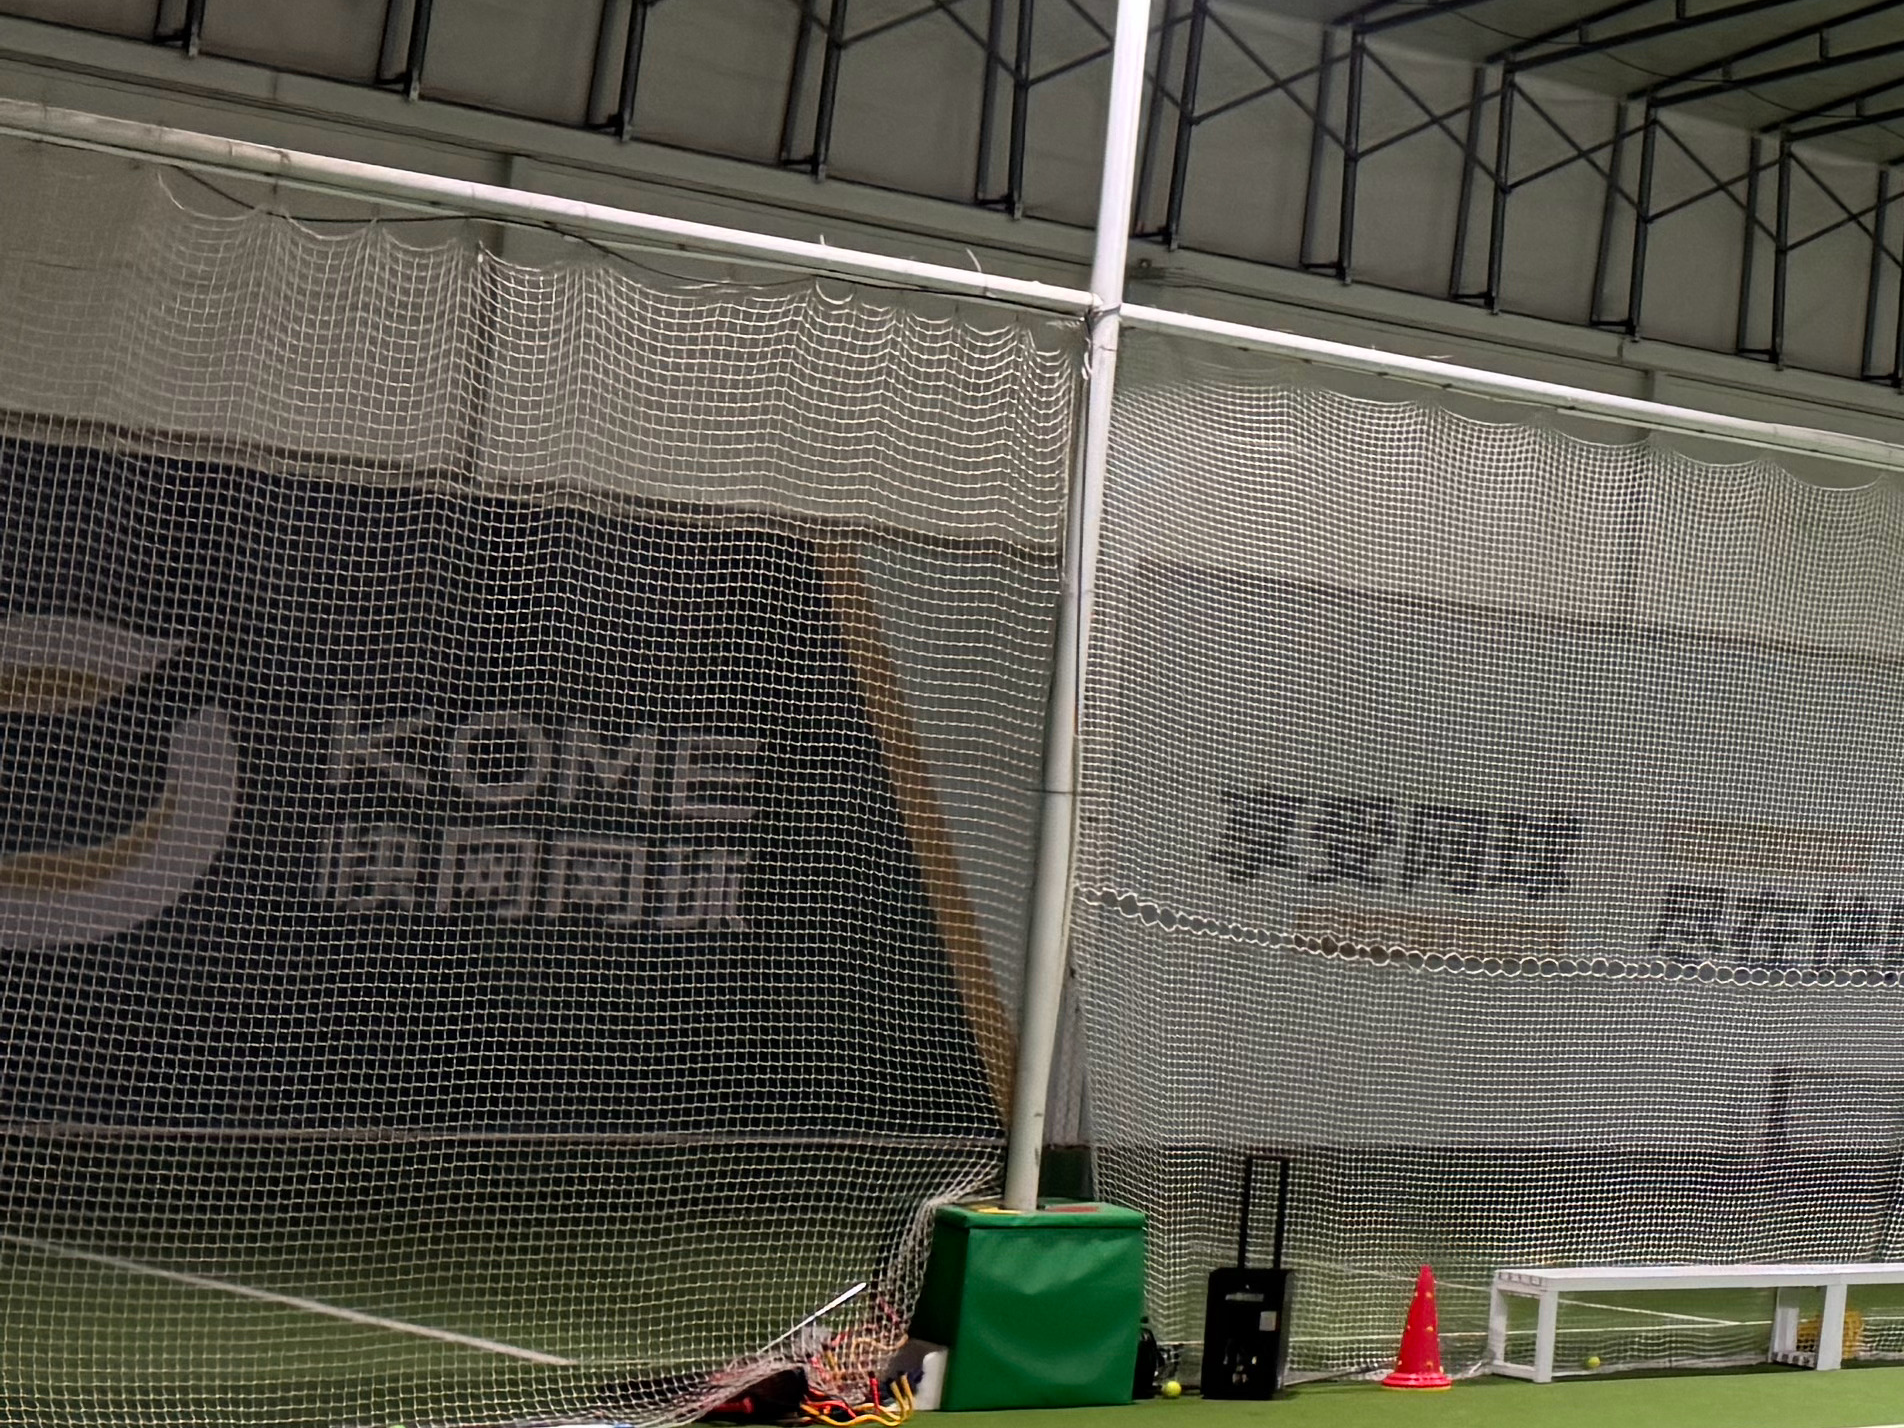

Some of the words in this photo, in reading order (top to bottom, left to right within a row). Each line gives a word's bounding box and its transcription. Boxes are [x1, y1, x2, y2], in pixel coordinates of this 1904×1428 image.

[327, 701, 767, 824] KOME
[1208, 786, 1581, 900] 享受网球
